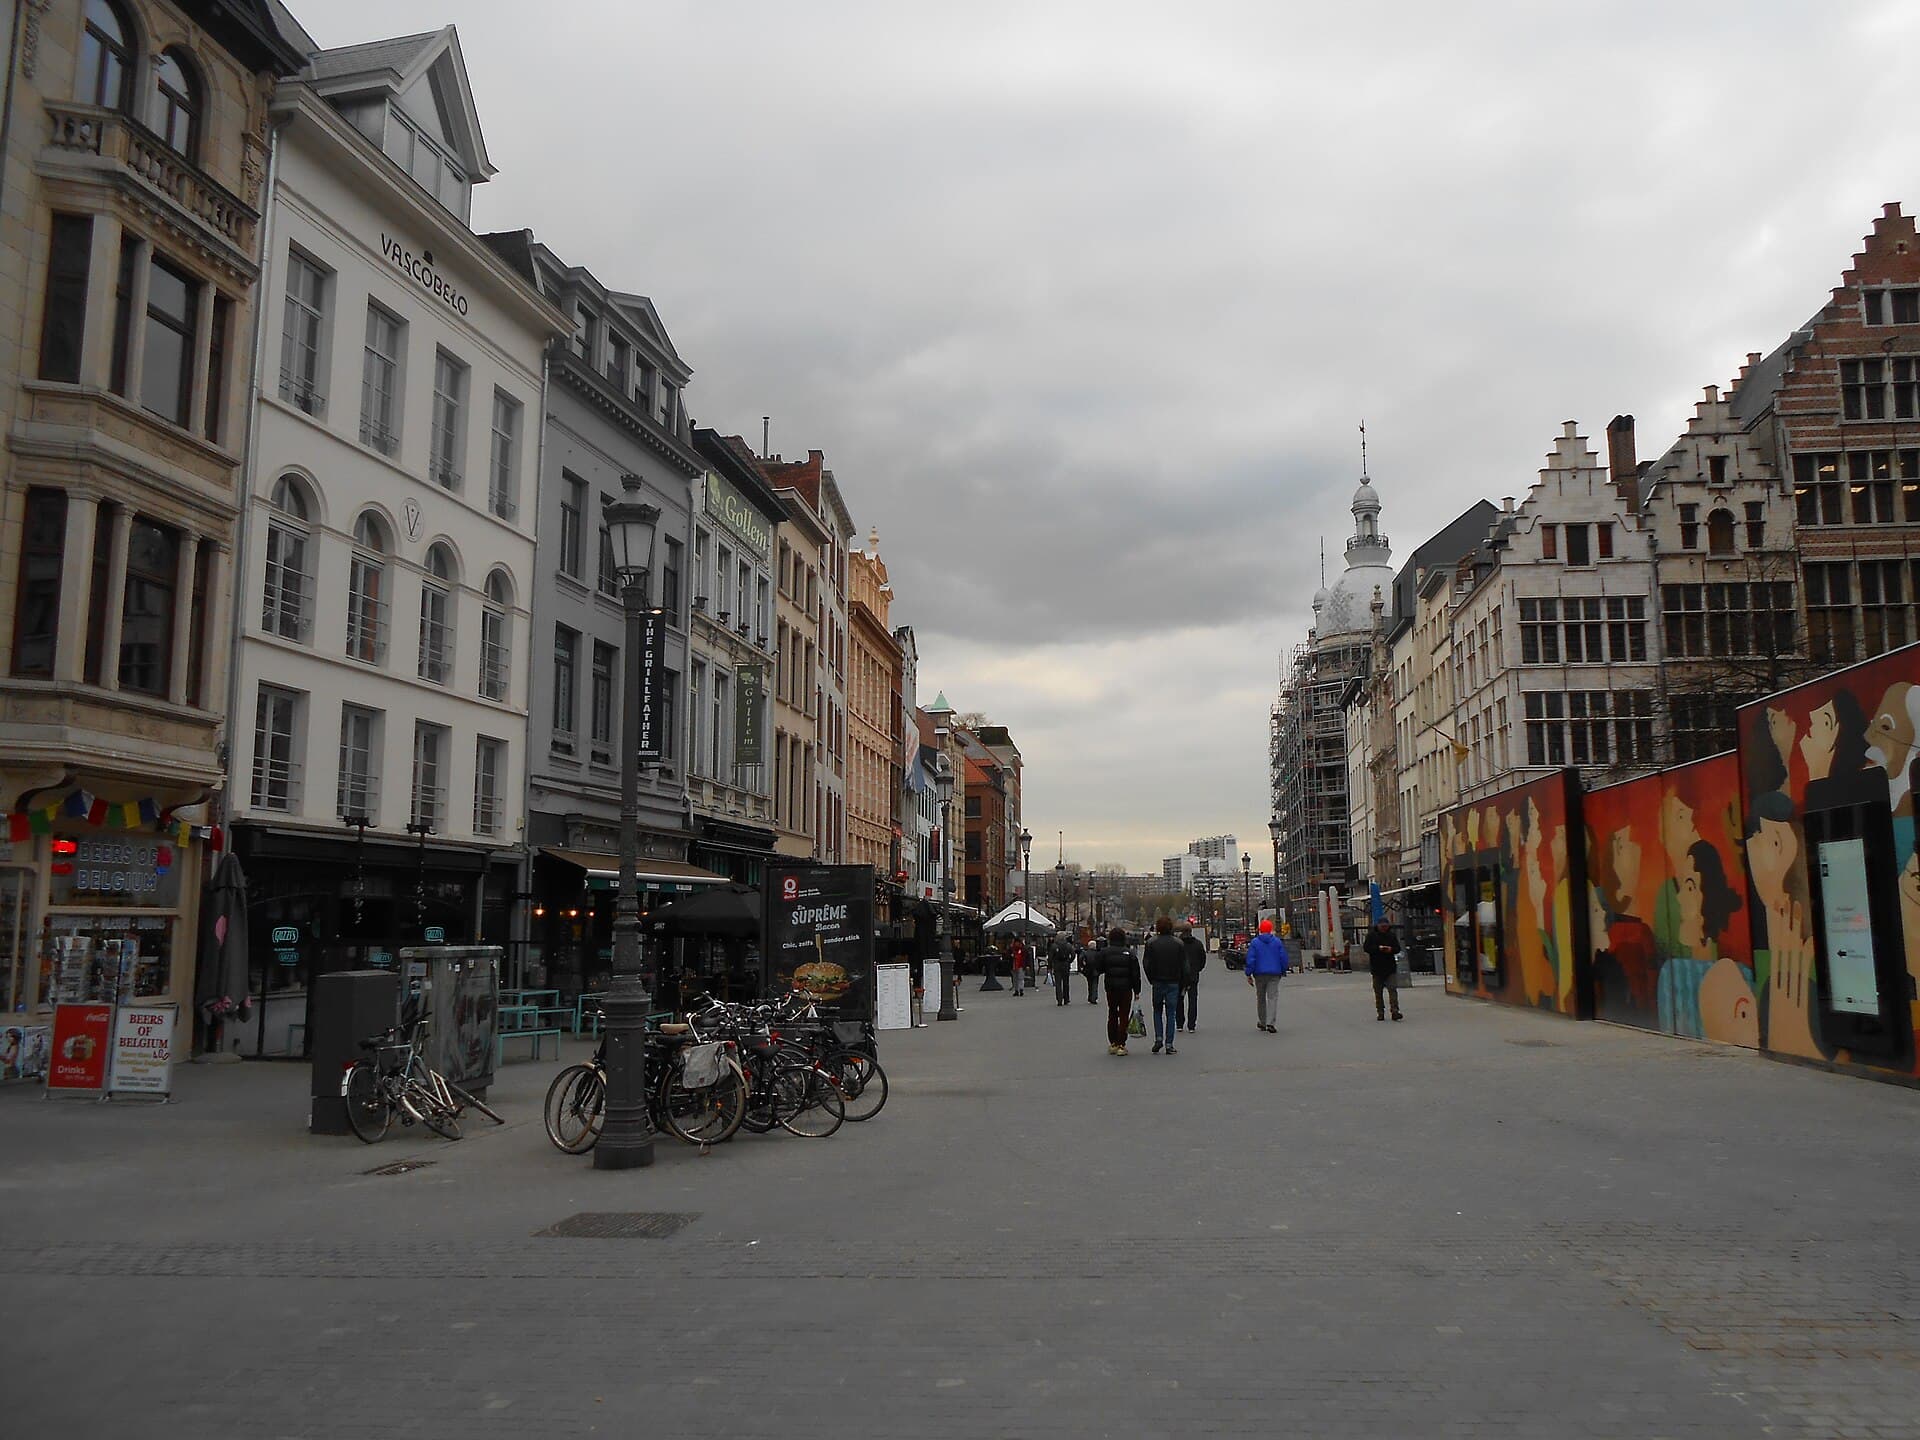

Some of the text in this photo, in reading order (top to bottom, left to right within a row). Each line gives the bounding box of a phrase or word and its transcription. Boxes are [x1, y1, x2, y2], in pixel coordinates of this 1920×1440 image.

[381, 233, 468, 316] VASCOBELO
[725, 496, 767, 551] Gollem
[646, 619, 654, 645] THE
[641, 650, 653, 749] GRILLFATHER
[743, 687, 754, 745] Gollem
[79, 842, 158, 866] BEERS OF
[78, 869, 157, 892] BELGIUM
[791, 904, 847, 925] SUPRÊME
[815, 922, 840, 931] Bacon
[824, 936, 844, 944] zonder
[129, 1014, 164, 1025] BEERS
[137, 1026, 152, 1036] OF
[119, 1037, 168, 1048] BELGIUM
[57, 1065, 86, 1074] Drinks
